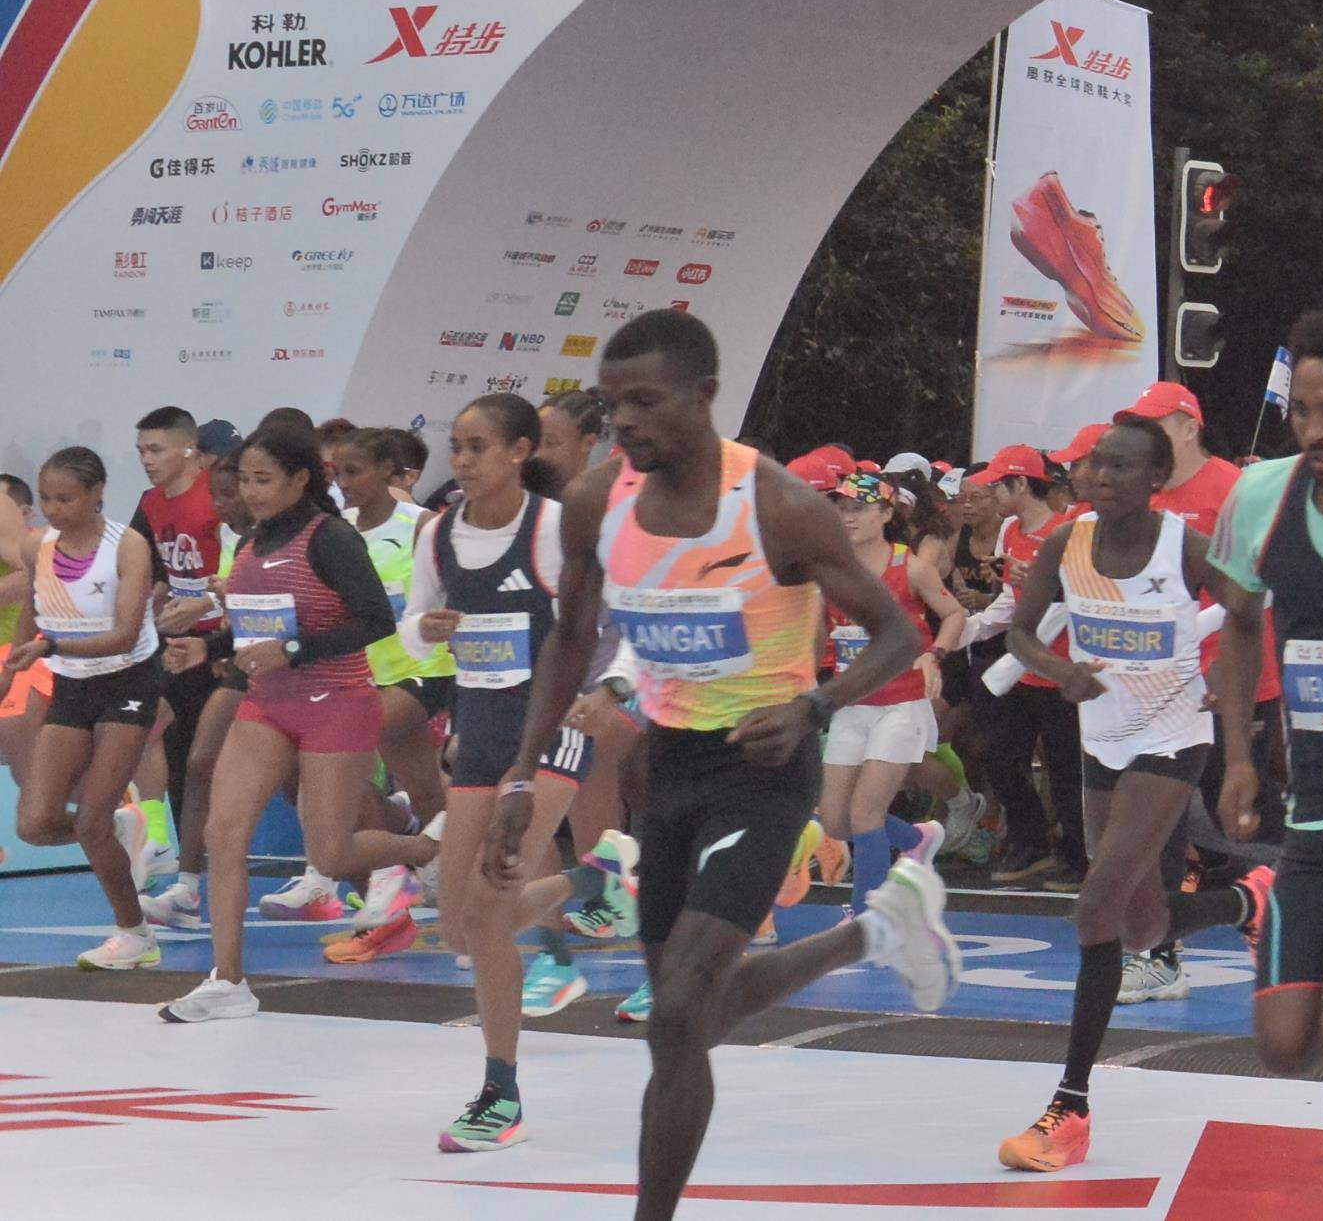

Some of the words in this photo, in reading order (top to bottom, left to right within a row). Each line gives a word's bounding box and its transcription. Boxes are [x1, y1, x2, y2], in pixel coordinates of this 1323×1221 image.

[430, 21, 506, 57] 特步
[228, 38, 327, 70] KOHLER
[1081, 50, 1132, 80] 特步
[401, 91, 465, 109] 万达广场
[167, 157, 215, 177] 佳得乐
[340, 153, 387, 167] SHOKZ
[322, 197, 377, 216] GymMax
[217, 253, 252, 272] keep
[520, 334, 545, 344] NBD
[621, 622, 725, 653] LANGAT
[1079, 624, 1162, 651] CHESIR
